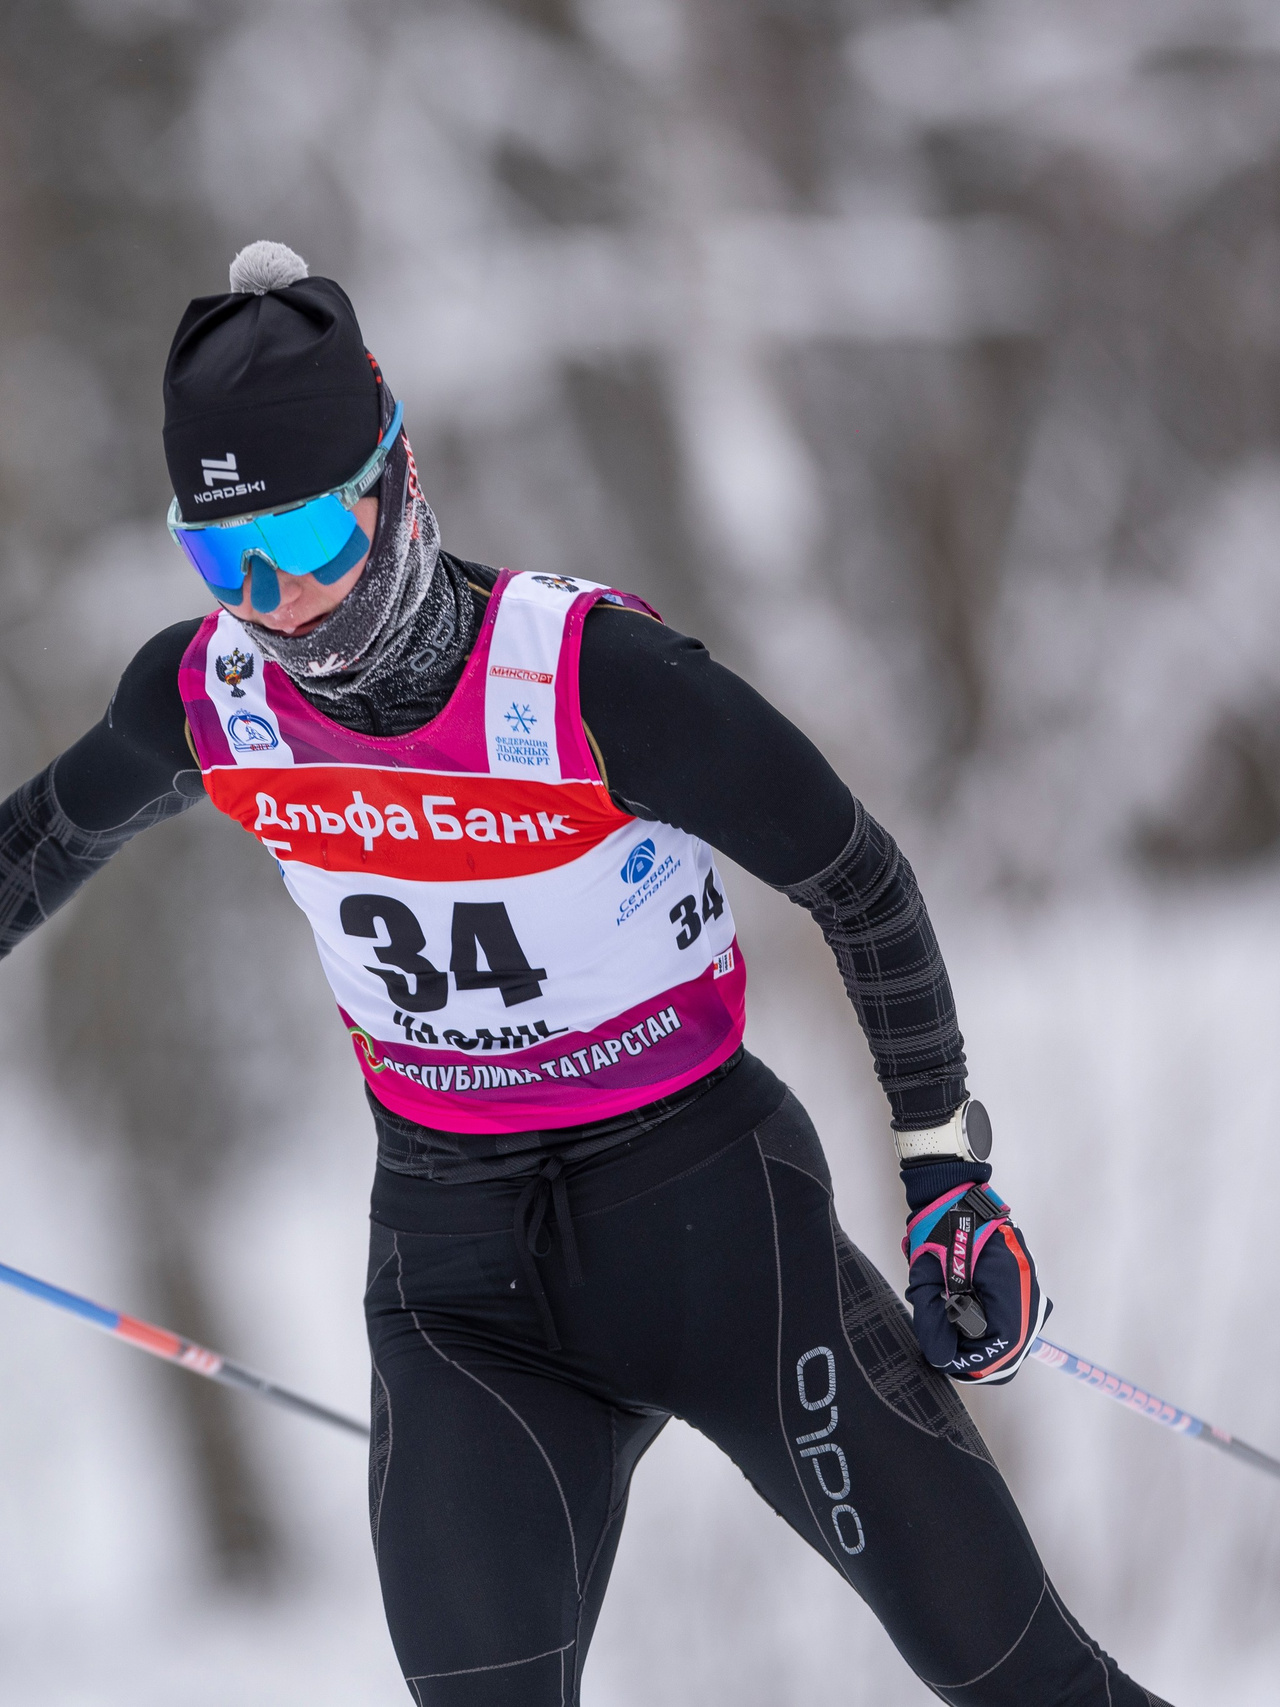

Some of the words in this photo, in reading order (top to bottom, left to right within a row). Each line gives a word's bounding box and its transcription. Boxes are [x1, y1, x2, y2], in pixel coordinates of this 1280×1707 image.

[194, 480, 266, 504] NORDSKI
[490, 667, 552, 684] МИНСПОРТ
[495, 736, 548, 748] ФЕДЕРАЦИЯ
[496, 745, 549, 757] ЛЫЖНЫХ
[497, 753, 535, 766] ГОНОК
[536, 757, 550, 766] РТ
[254, 790, 419, 851] Альфа
[422, 795, 579, 844] Банк
[669, 866, 724, 950] 34
[339, 893, 547, 1013] 34
[539, 1005, 682, 1079] ТАТАРСТАН
[951, 1337, 1009, 1371] MOAX
